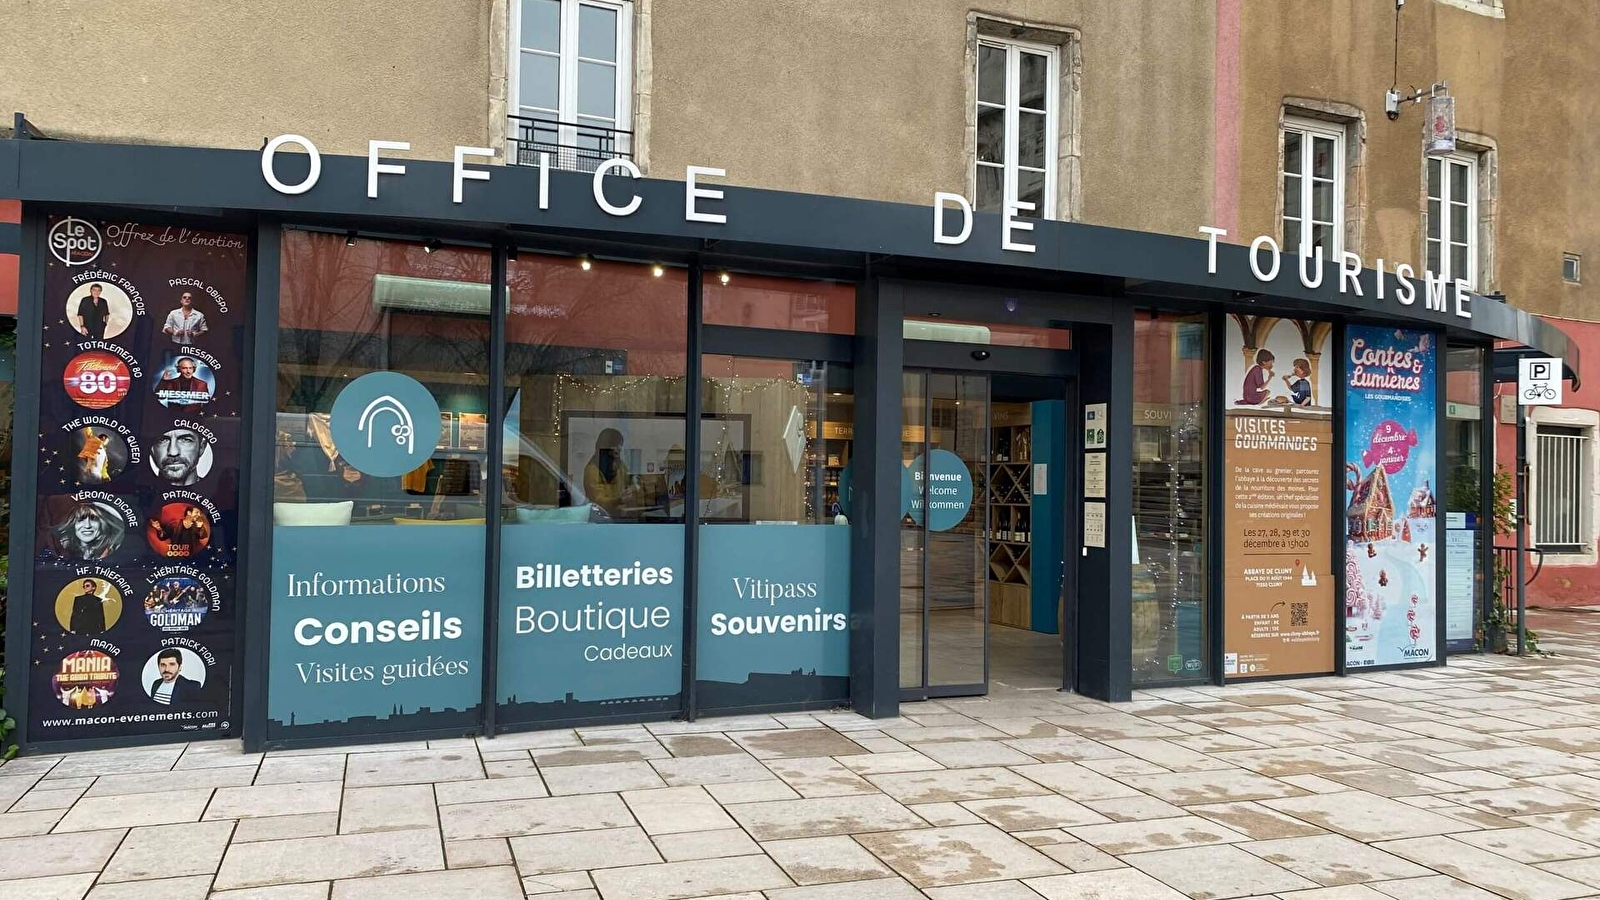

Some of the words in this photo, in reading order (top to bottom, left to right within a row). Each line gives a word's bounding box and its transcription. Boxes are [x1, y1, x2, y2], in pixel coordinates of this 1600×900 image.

[67, 216, 85, 236] Le
[107, 222, 157, 248] Offrez
[159, 226, 177, 244] de
[260, 133, 727, 224] OFFICE
[933, 191, 1037, 254] DE
[1198, 225, 1473, 320] TOURISME
[53, 232, 97, 267] Spot
[72, 269, 119, 285] FRÉDÉRIC
[118, 277, 146, 316] FRANÇOIS
[168, 277, 204, 290] PASCAL
[205, 284, 229, 315] OBISPO
[77, 340, 138, 365] TOTALEMENT
[132, 365, 143, 378] 80
[181, 346, 222, 371] MESSMER
[1350, 338, 1412, 369] Contes
[1413, 359, 1423, 373] &
[80, 371, 117, 394] 80
[1350, 366, 1420, 391] Lumières
[1534, 365, 1546, 378] P
[159, 389, 210, 400] MESSMER
[1374, 393, 1412, 402] GOURMANDISES
[174, 419, 218, 445] CALOGERO
[1235, 418, 1286, 434] VISITES
[1373, 433, 1407, 444] décembre
[1385, 424, 1392, 434] 9
[61, 418, 81, 432] THE
[83, 415, 118, 428] WORLD
[118, 425, 131, 436] OF
[126, 435, 140, 464] QUEEN
[1235, 434, 1318, 451] GOURMANDES
[1388, 446, 1394, 454] 4
[1379, 454, 1405, 465] janvier
[914, 471, 962, 481] Binvenue
[71, 490, 114, 502] VÉRONIC
[113, 497, 138, 528] DICAIRE
[162, 490, 202, 502] PATRICK
[200, 498, 222, 524] BRUEL
[1243, 529, 1257, 537] Les
[1269, 529, 1280, 537] 28,
[1282, 529, 1291, 537] 29
[1292, 529, 1299, 537] et
[1301, 529, 1311, 537] 30
[1243, 539, 1279, 548] décembre
[1281, 539, 1286, 547] à
[1288, 539, 1309, 549] 15h00
[76, 566, 92, 576] HF.
[516, 560, 674, 590] Billetteries
[198, 573, 221, 612] GOLDMAN
[287, 571, 446, 598] Informations
[733, 576, 818, 607] Vitipass
[150, 613, 201, 627] GOLDMAN
[294, 609, 463, 646] Conseils
[515, 601, 671, 639] Boutique
[710, 607, 847, 637] Souvenirs
[90, 638, 121, 657] MANIA
[160, 637, 200, 650] PATRICK
[198, 646, 216, 667] FIORI
[583, 643, 673, 662] Cadeaux
[62, 656, 111, 673] MANIA
[90, 671, 117, 680] TRIBUTE
[295, 662, 375, 685] Visites
[381, 655, 469, 686] guidées
[42, 710, 218, 728] www.macon-evenements.com
